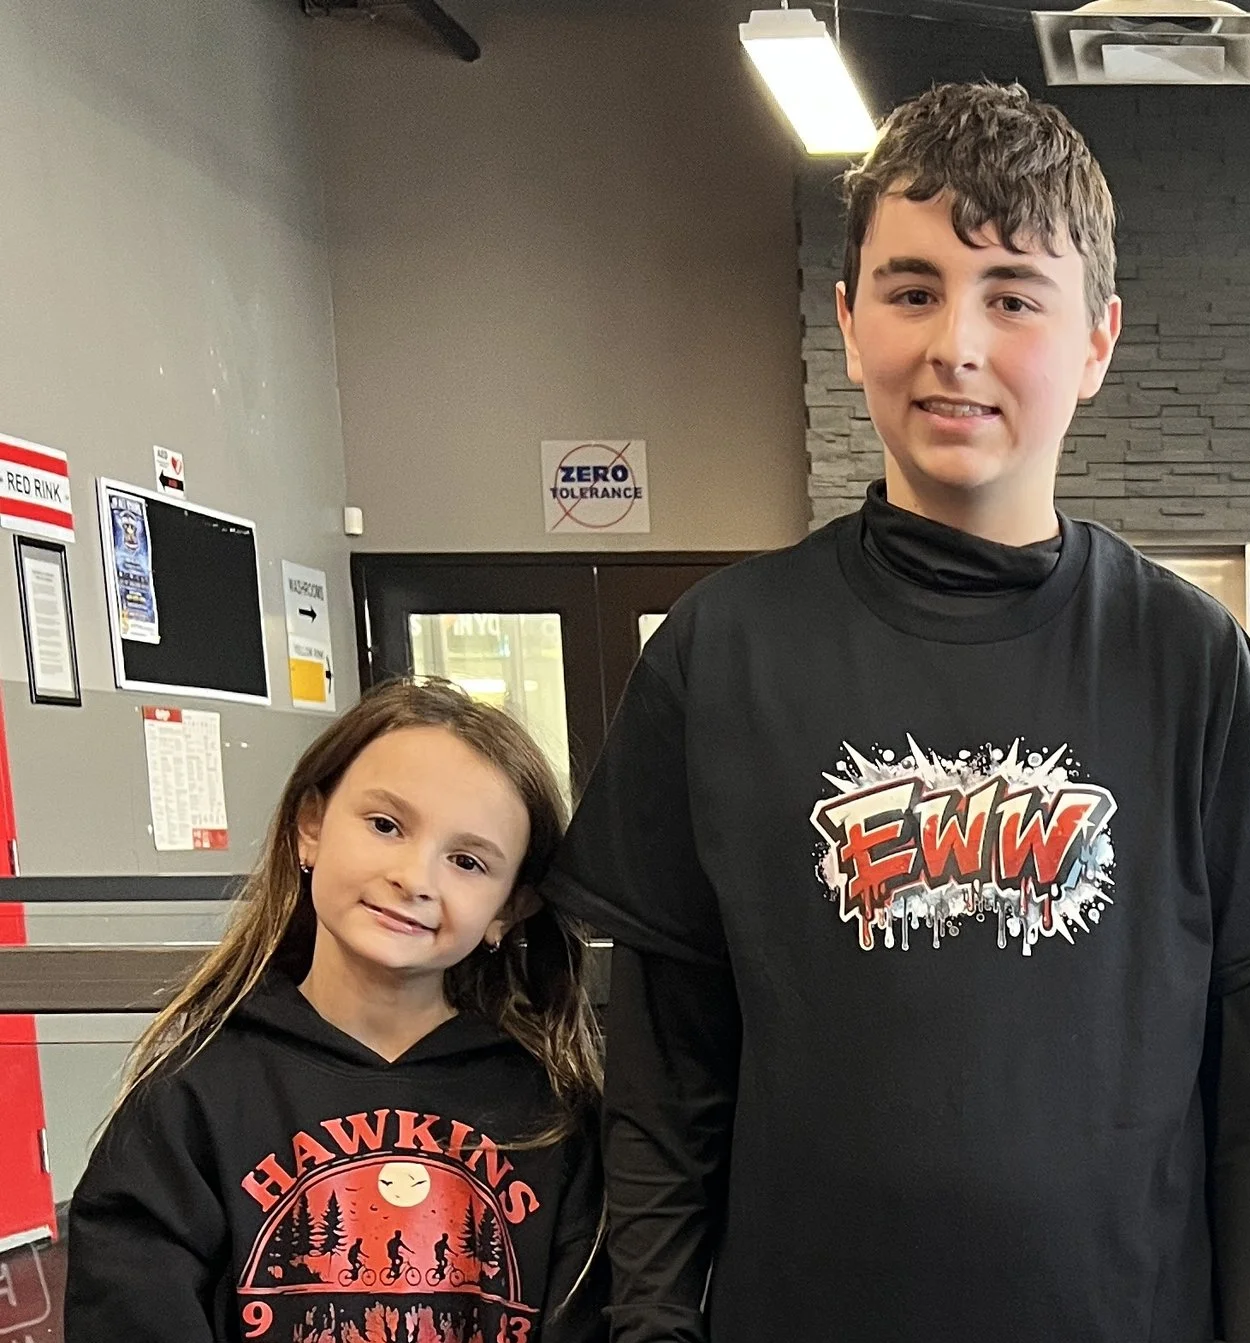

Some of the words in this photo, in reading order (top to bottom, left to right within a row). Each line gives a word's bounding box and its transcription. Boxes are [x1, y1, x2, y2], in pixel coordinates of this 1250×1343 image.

[7, 472, 31, 495] RED
[34, 478, 62, 503] RINK
[560, 465, 629, 482] ZERO
[550, 487, 643, 499] TOLERANCE
[817, 779, 1112, 908] EWW
[241, 1108, 541, 1225] HAWKINS
